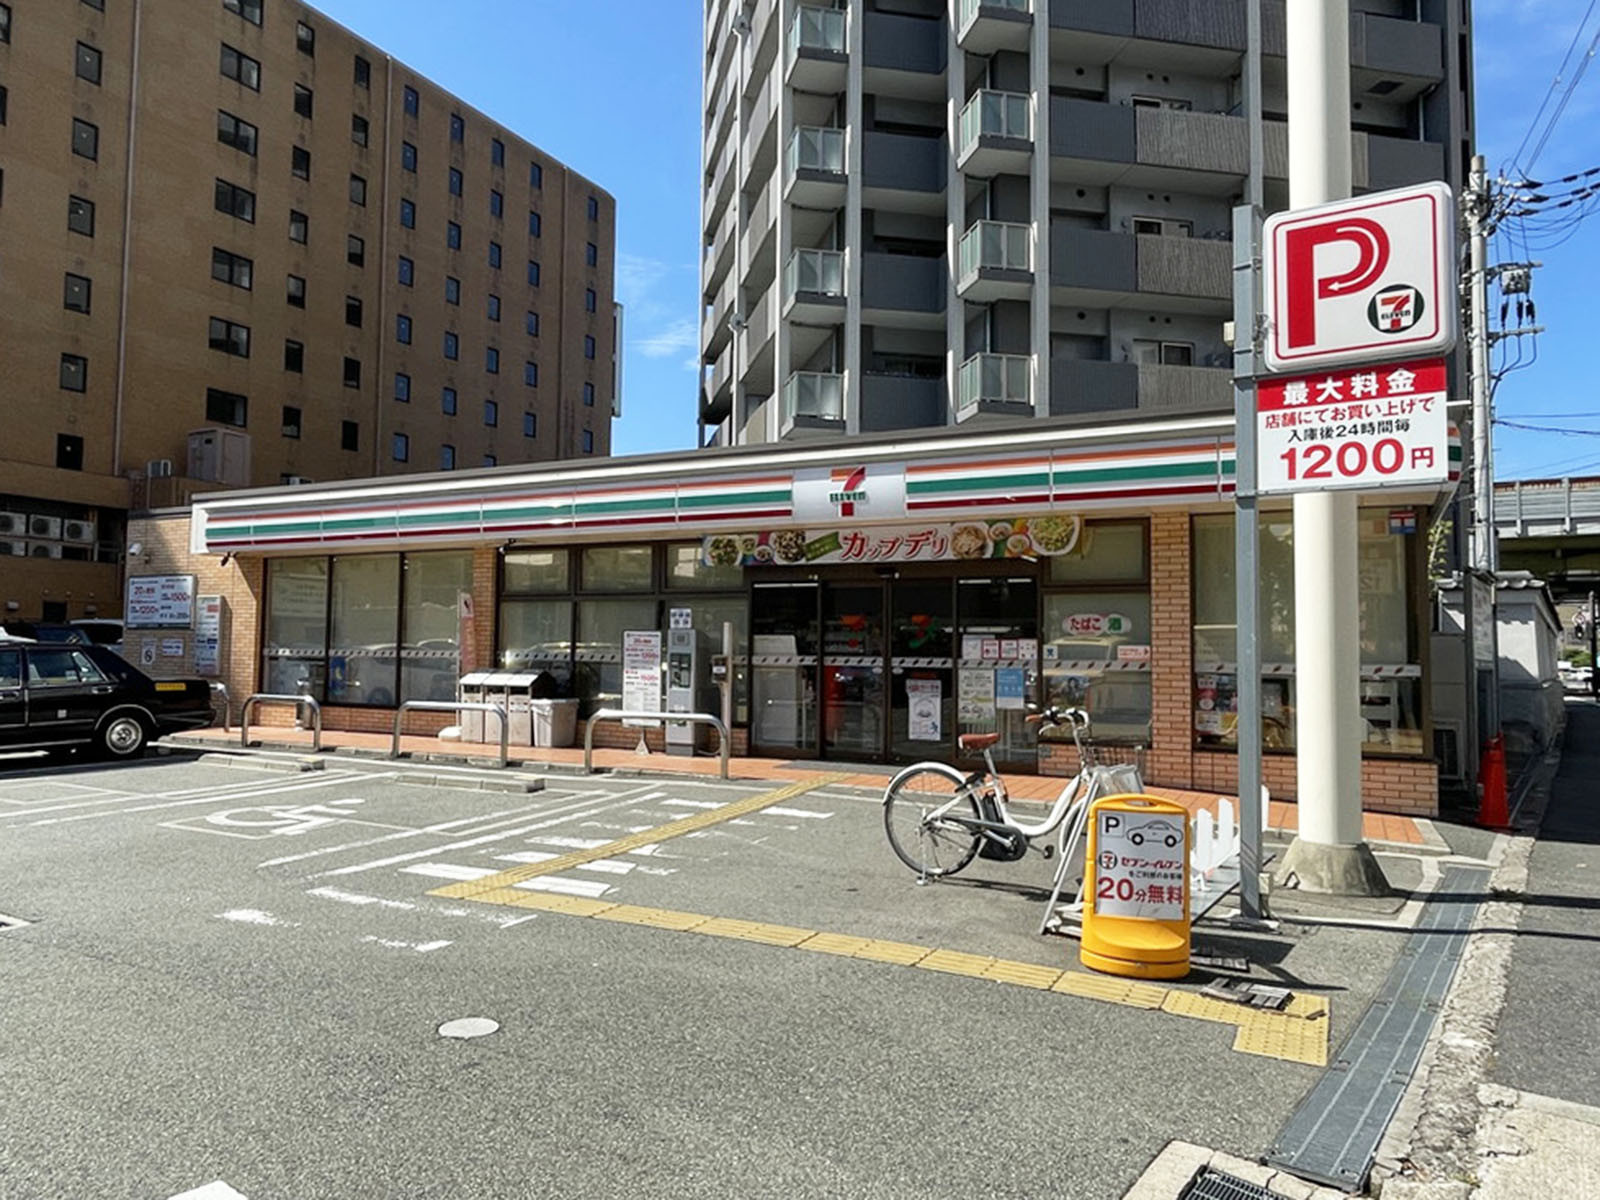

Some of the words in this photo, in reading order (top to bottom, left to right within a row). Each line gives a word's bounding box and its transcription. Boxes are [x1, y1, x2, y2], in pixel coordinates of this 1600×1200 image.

[1286, 218, 1390, 349] P
[1381, 294, 1410, 331] 7
[1283, 367, 1417, 405] 最大料金
[1288, 418, 1411, 443] 入庫後24時間毎
[831, 466, 866, 517] 7
[840, 526, 948, 560] カップデリ
[1070, 617, 1102, 631] たばこ
[1105, 816, 1120, 834] P
[1098, 875, 1183, 906] 20分無料
